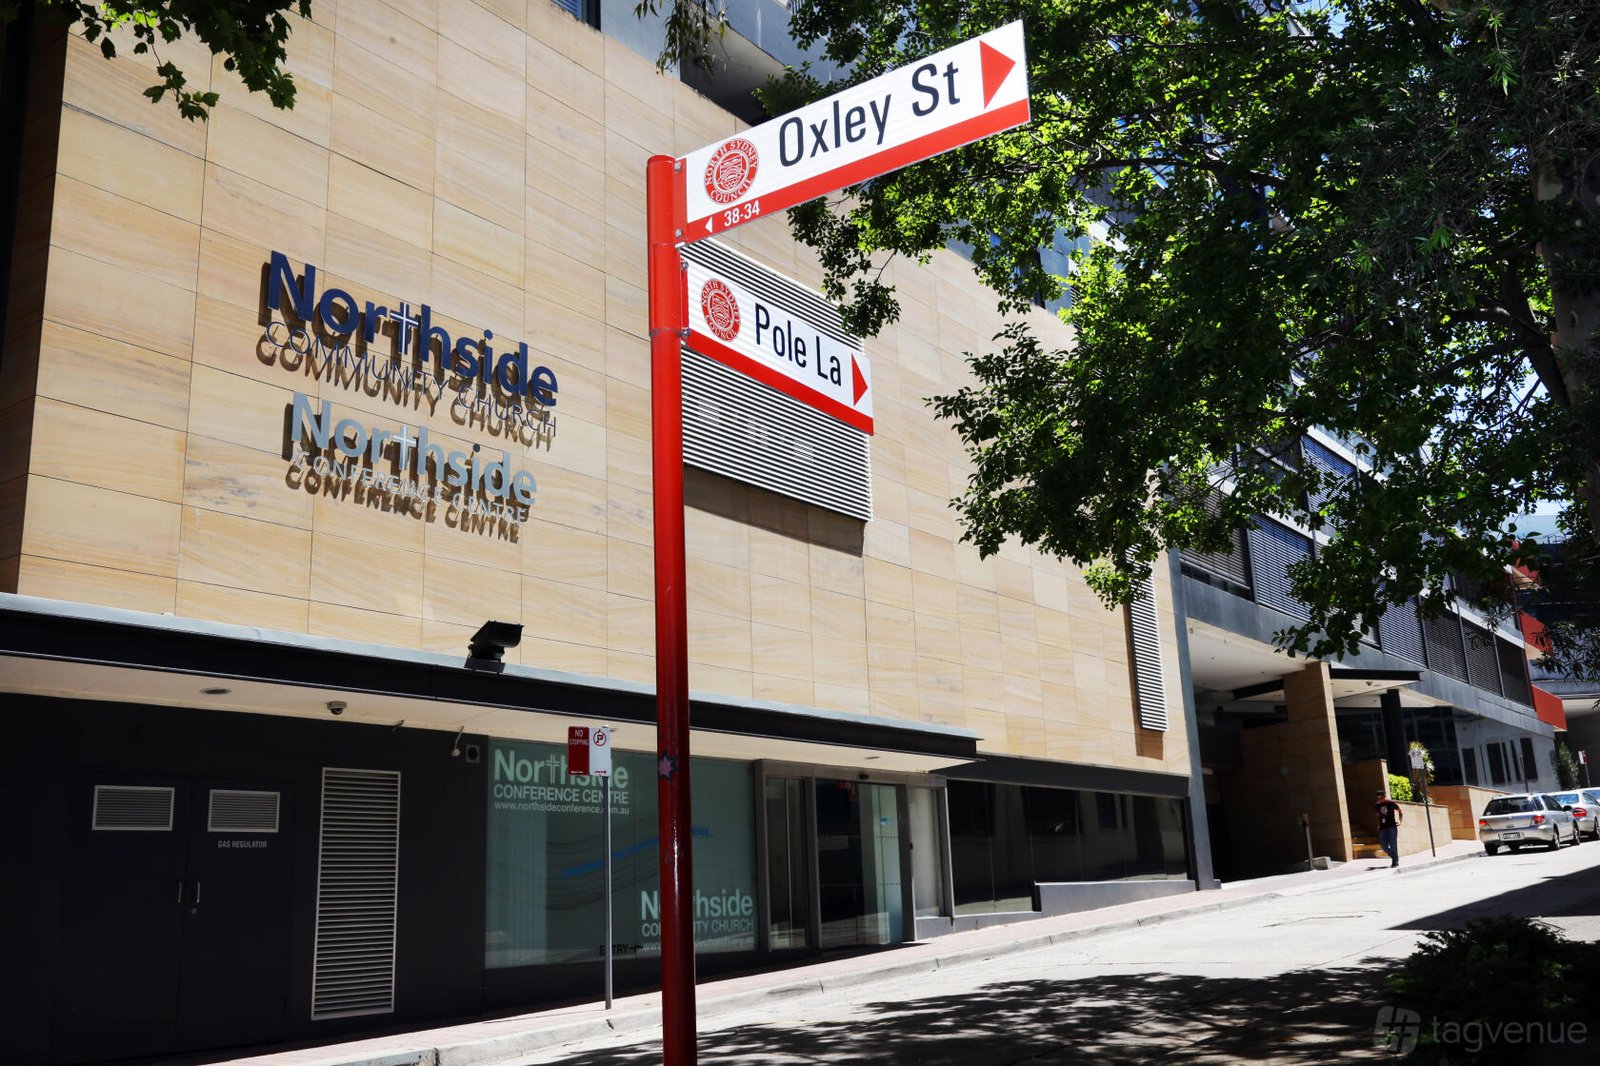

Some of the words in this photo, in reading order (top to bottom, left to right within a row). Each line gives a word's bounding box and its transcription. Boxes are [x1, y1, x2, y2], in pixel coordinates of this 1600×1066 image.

[778, 93, 892, 167] Oxley
[911, 61, 960, 117] St
[706, 146, 727, 185] NORTH
[729, 140, 758, 168] SYDNEY
[710, 179, 751, 203] COUNCIL
[724, 200, 760, 226] 38-34
[267, 250, 558, 407] Northside
[705, 314, 737, 340] COUNCIL
[755, 302, 807, 368] Pole
[816, 335, 842, 387] La
[266, 321, 449, 400] COMMUNITY
[457, 386, 556, 437] CHURCH
[291, 391, 537, 506] Northside
[292, 450, 443, 504] CONFERENCE
[453, 493, 528, 527] CENTRE
[574, 729, 583, 737] NO
[494, 784, 579, 802] CONFERENCE
[583, 789, 629, 804] CERE
[494, 800, 629, 815] www.northsideconference.m.au
[217, 840, 231, 849] GAS
[232, 840, 267, 849] REGULATOR
[641, 889, 753, 920] Nhside
[712, 918, 754, 933] CHURCH
